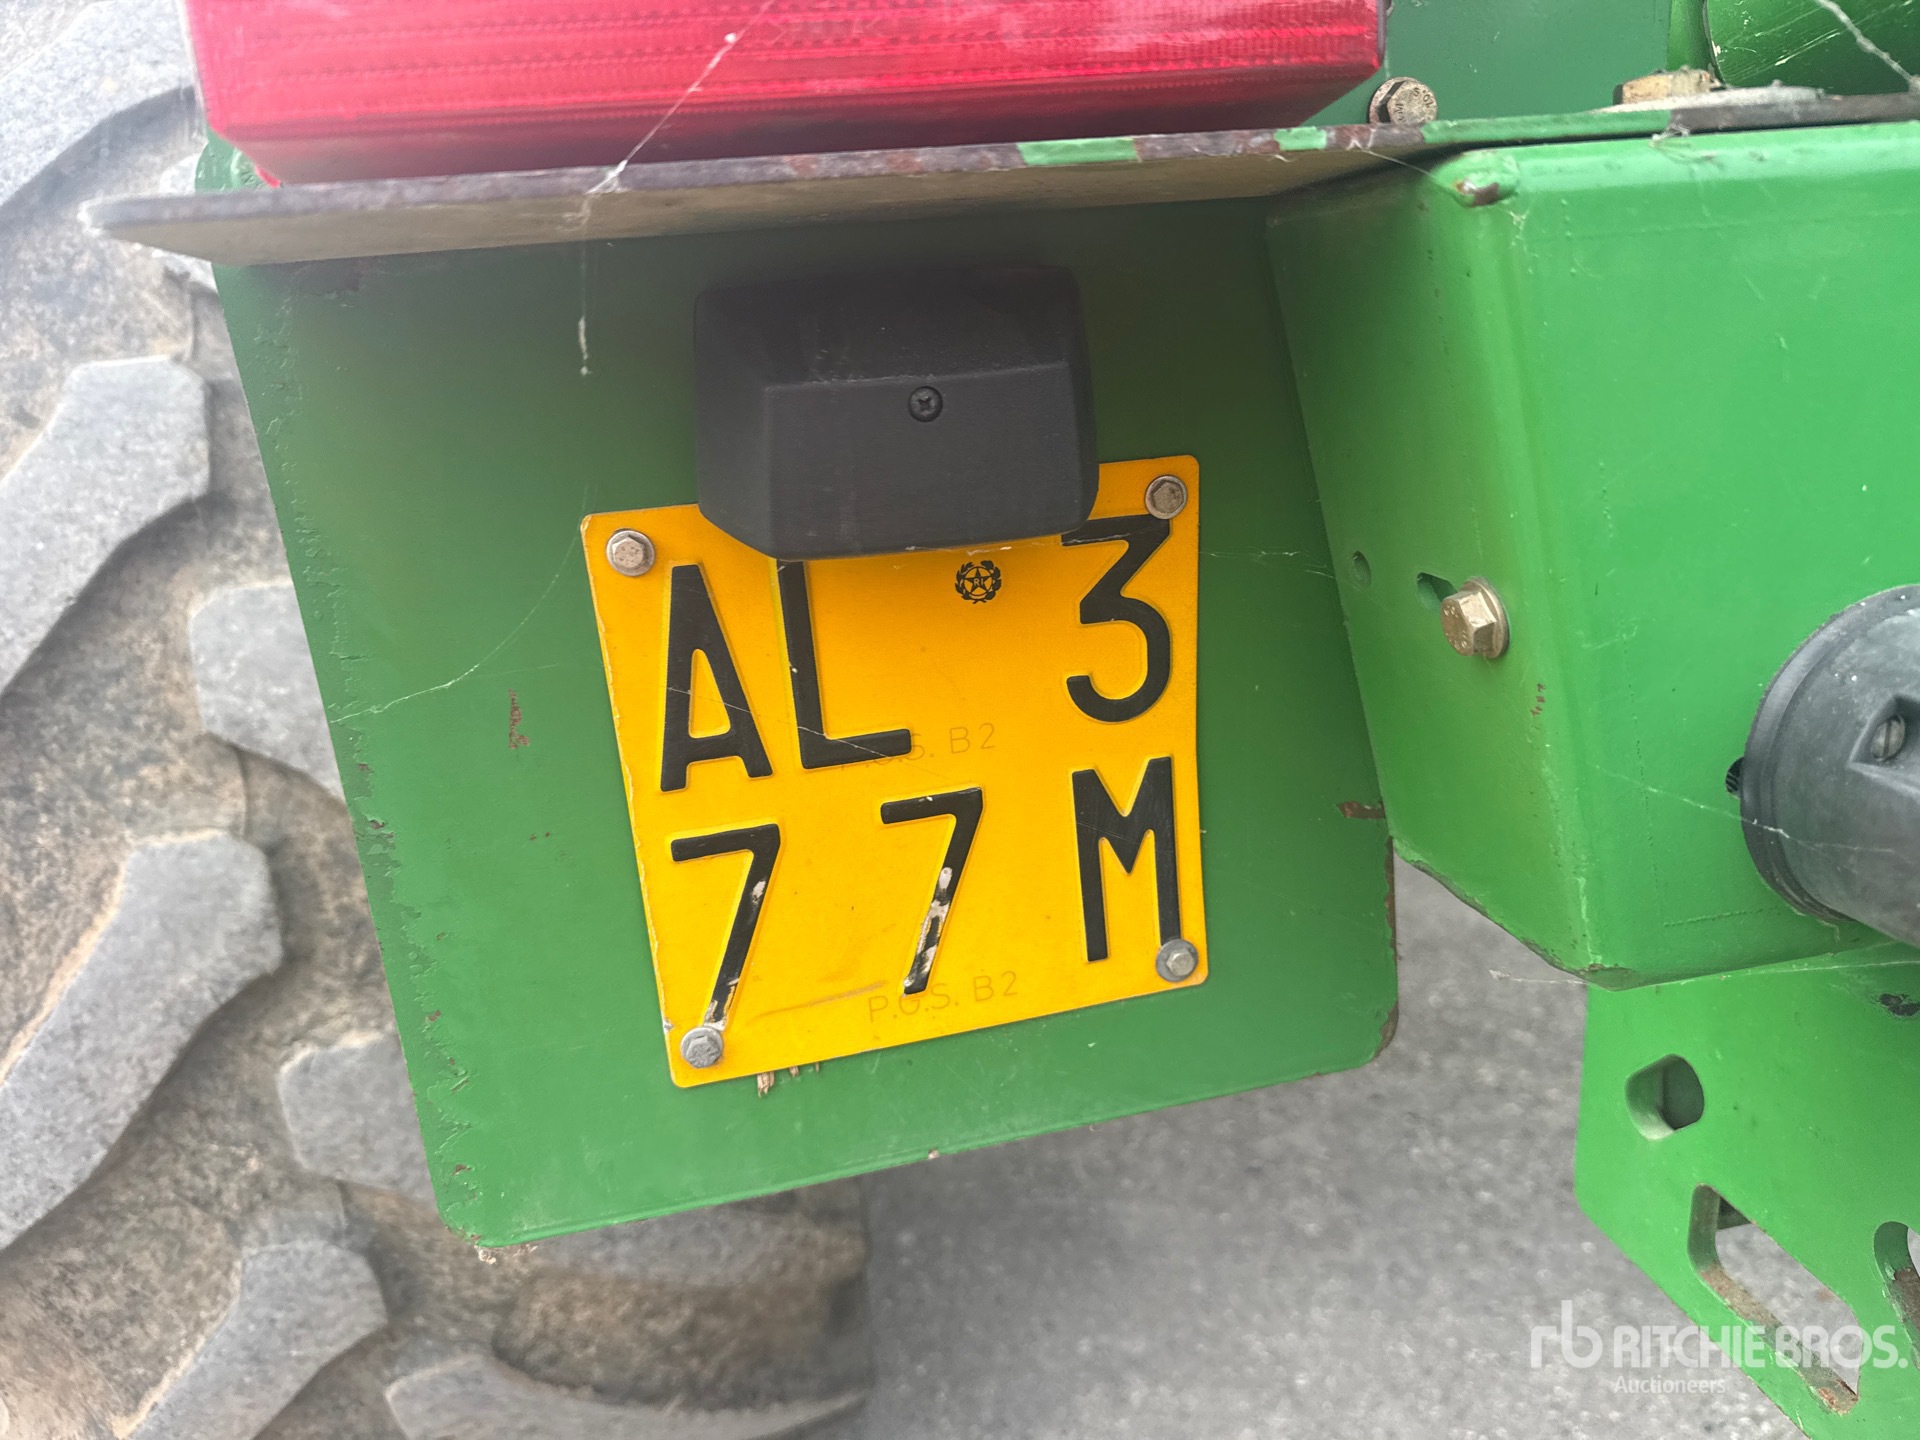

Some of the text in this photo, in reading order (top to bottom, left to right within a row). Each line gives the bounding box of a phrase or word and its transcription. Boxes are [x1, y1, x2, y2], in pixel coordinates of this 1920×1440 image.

[660, 558, 912, 792] AL
[949, 722, 996, 755] B2
[973, 970, 1018, 1002] B2
